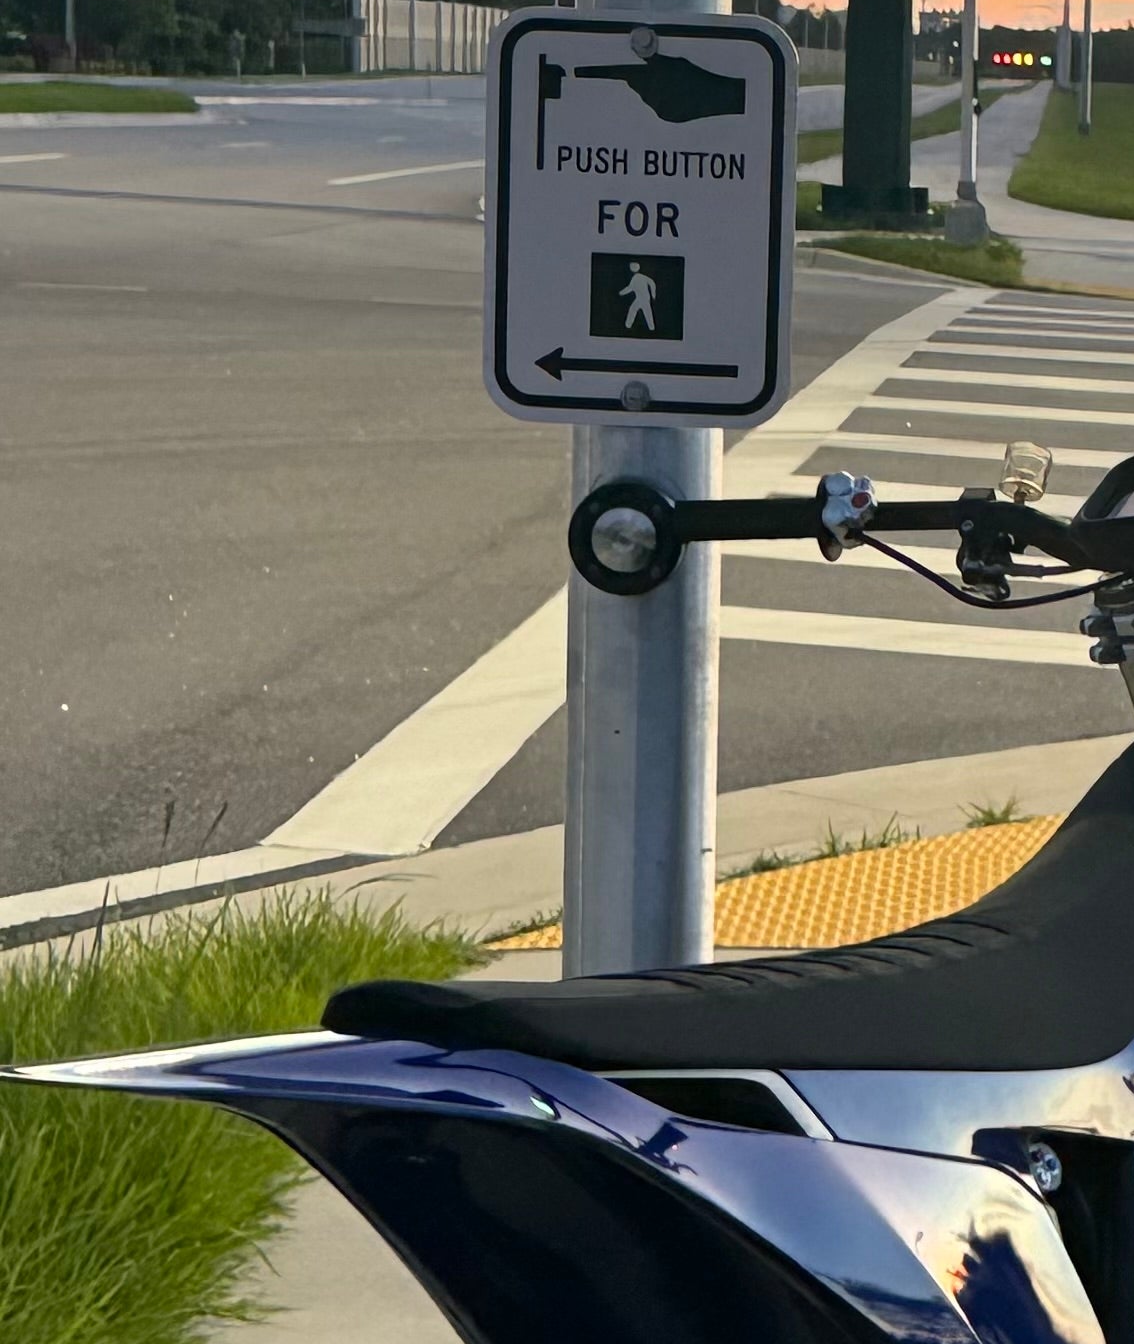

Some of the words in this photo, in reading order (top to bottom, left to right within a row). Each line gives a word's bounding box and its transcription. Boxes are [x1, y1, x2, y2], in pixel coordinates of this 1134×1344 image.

[557, 145, 628, 176] PUSH
[644, 149, 745, 180] BUTTON
[597, 199, 680, 238] FOR
